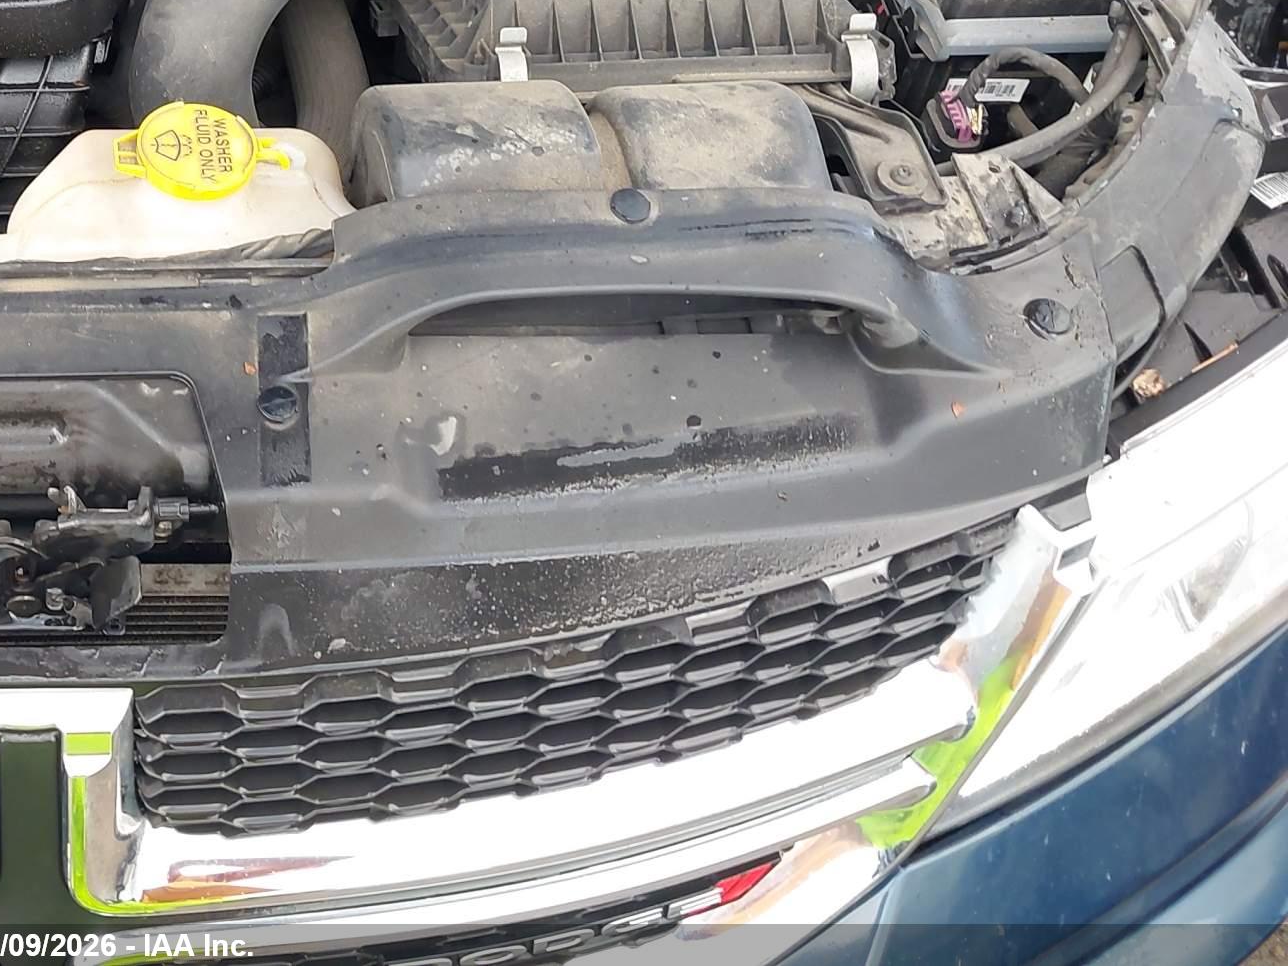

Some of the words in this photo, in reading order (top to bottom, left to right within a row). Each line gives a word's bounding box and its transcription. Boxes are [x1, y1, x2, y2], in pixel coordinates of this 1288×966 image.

[194, 108, 211, 145] FLUID
[213, 117, 233, 173] WASHER
[199, 149, 217, 183] ONLY
